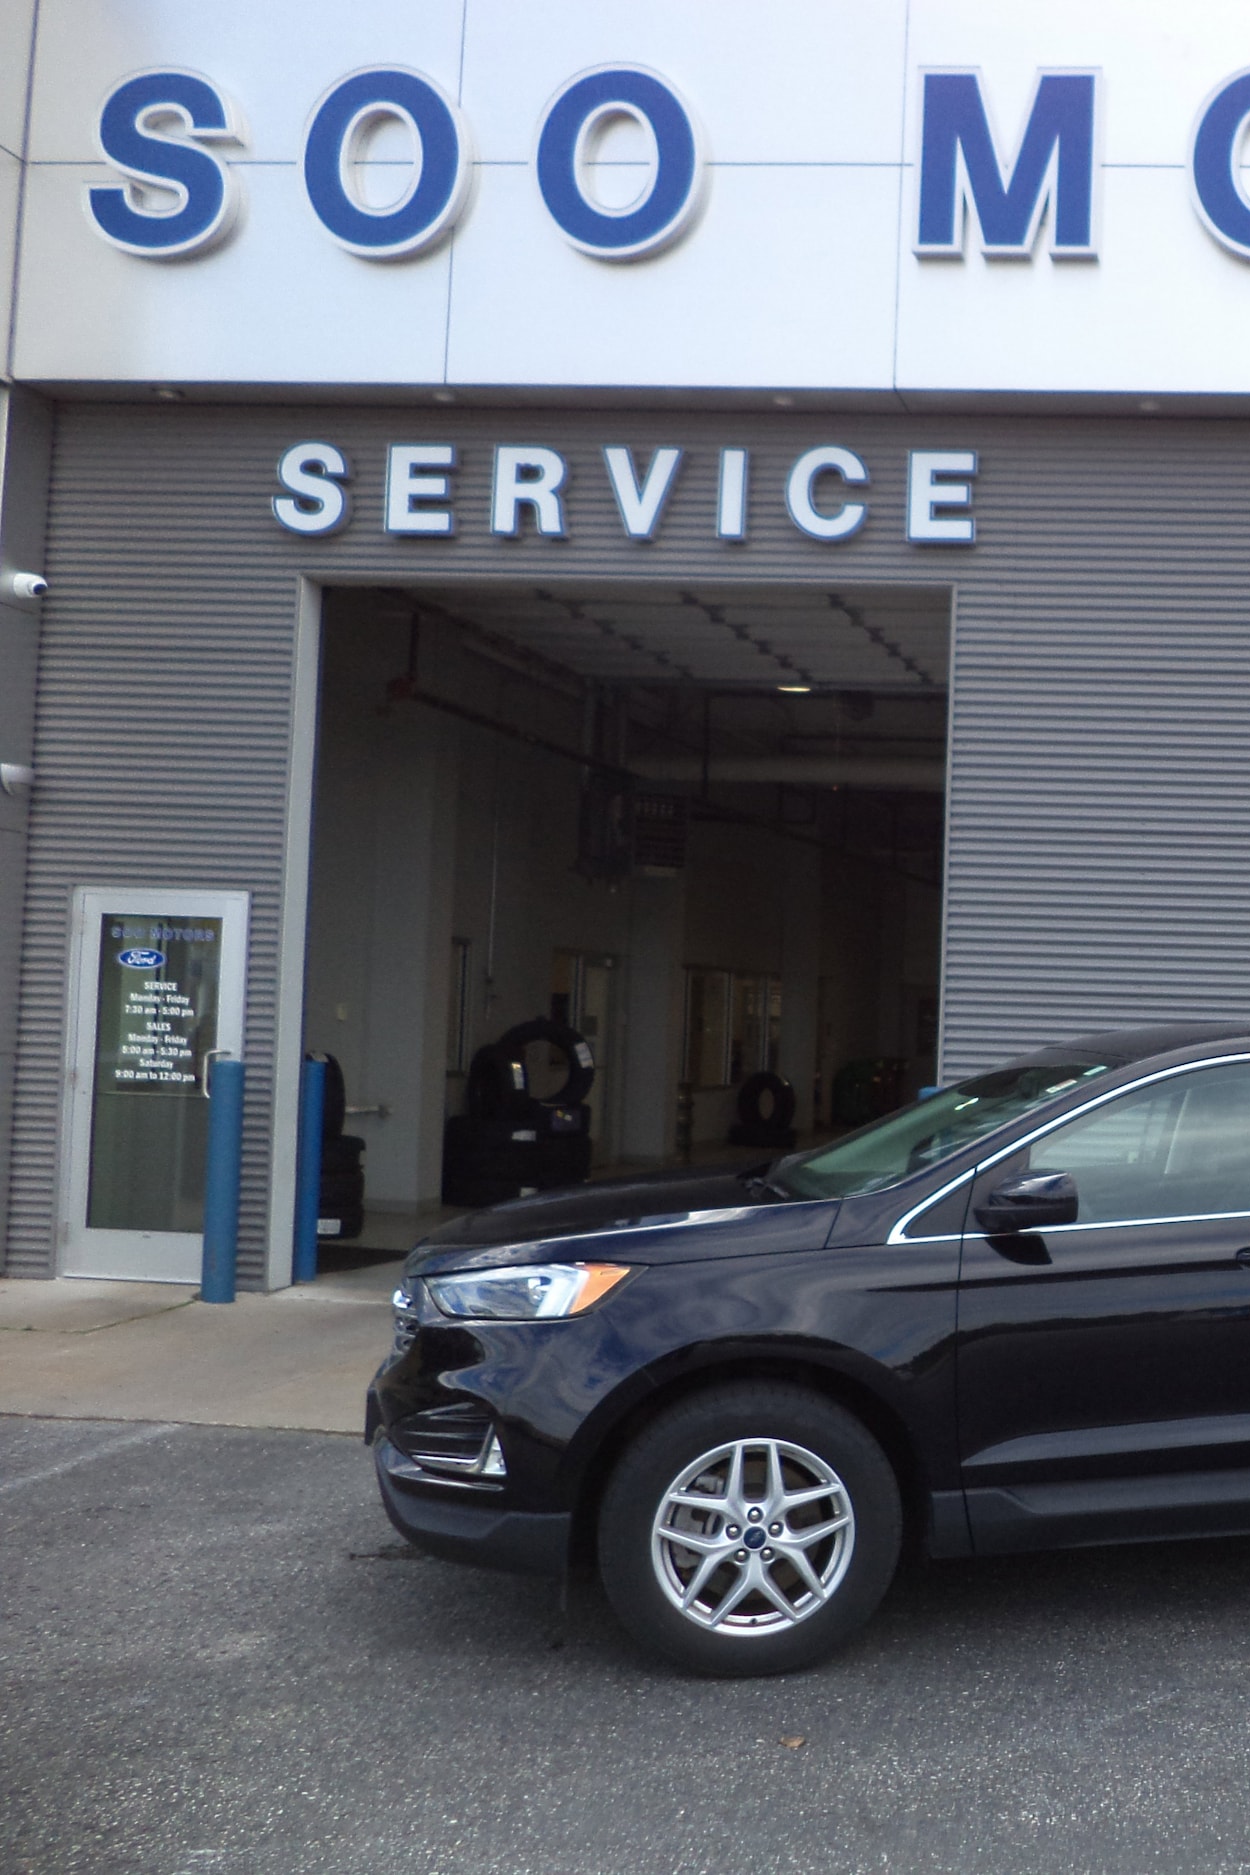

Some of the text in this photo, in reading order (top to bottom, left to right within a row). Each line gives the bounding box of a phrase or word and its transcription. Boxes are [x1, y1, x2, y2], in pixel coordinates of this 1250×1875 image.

[84, 63, 706, 261] SOO
[271, 440, 979, 545] SERVICE
[150, 928, 215, 941] MOTORS
[144, 981, 178, 992] SERVICE
[130, 993, 161, 1004] Monday
[166, 995, 190, 1006] Friday
[125, 1004, 143, 1014] 7:30
[144, 1007, 156, 1015] am
[162, 1006, 180, 1016] 5:00
[182, 1009, 194, 1018] pm
[146, 1022, 171, 1032] SALES
[128, 1034, 159, 1045] Monday
[164, 1036, 188, 1047] Friday
[142, 1048, 155, 1056] am
[180, 1050, 192, 1058] pm
[140, 1059, 174, 1070] Saturday
[136, 1072, 148, 1080] am
[150, 1072, 158, 1080] to
[160, 1072, 182, 1082] 12:00
[183, 1075, 196, 1084] pm
